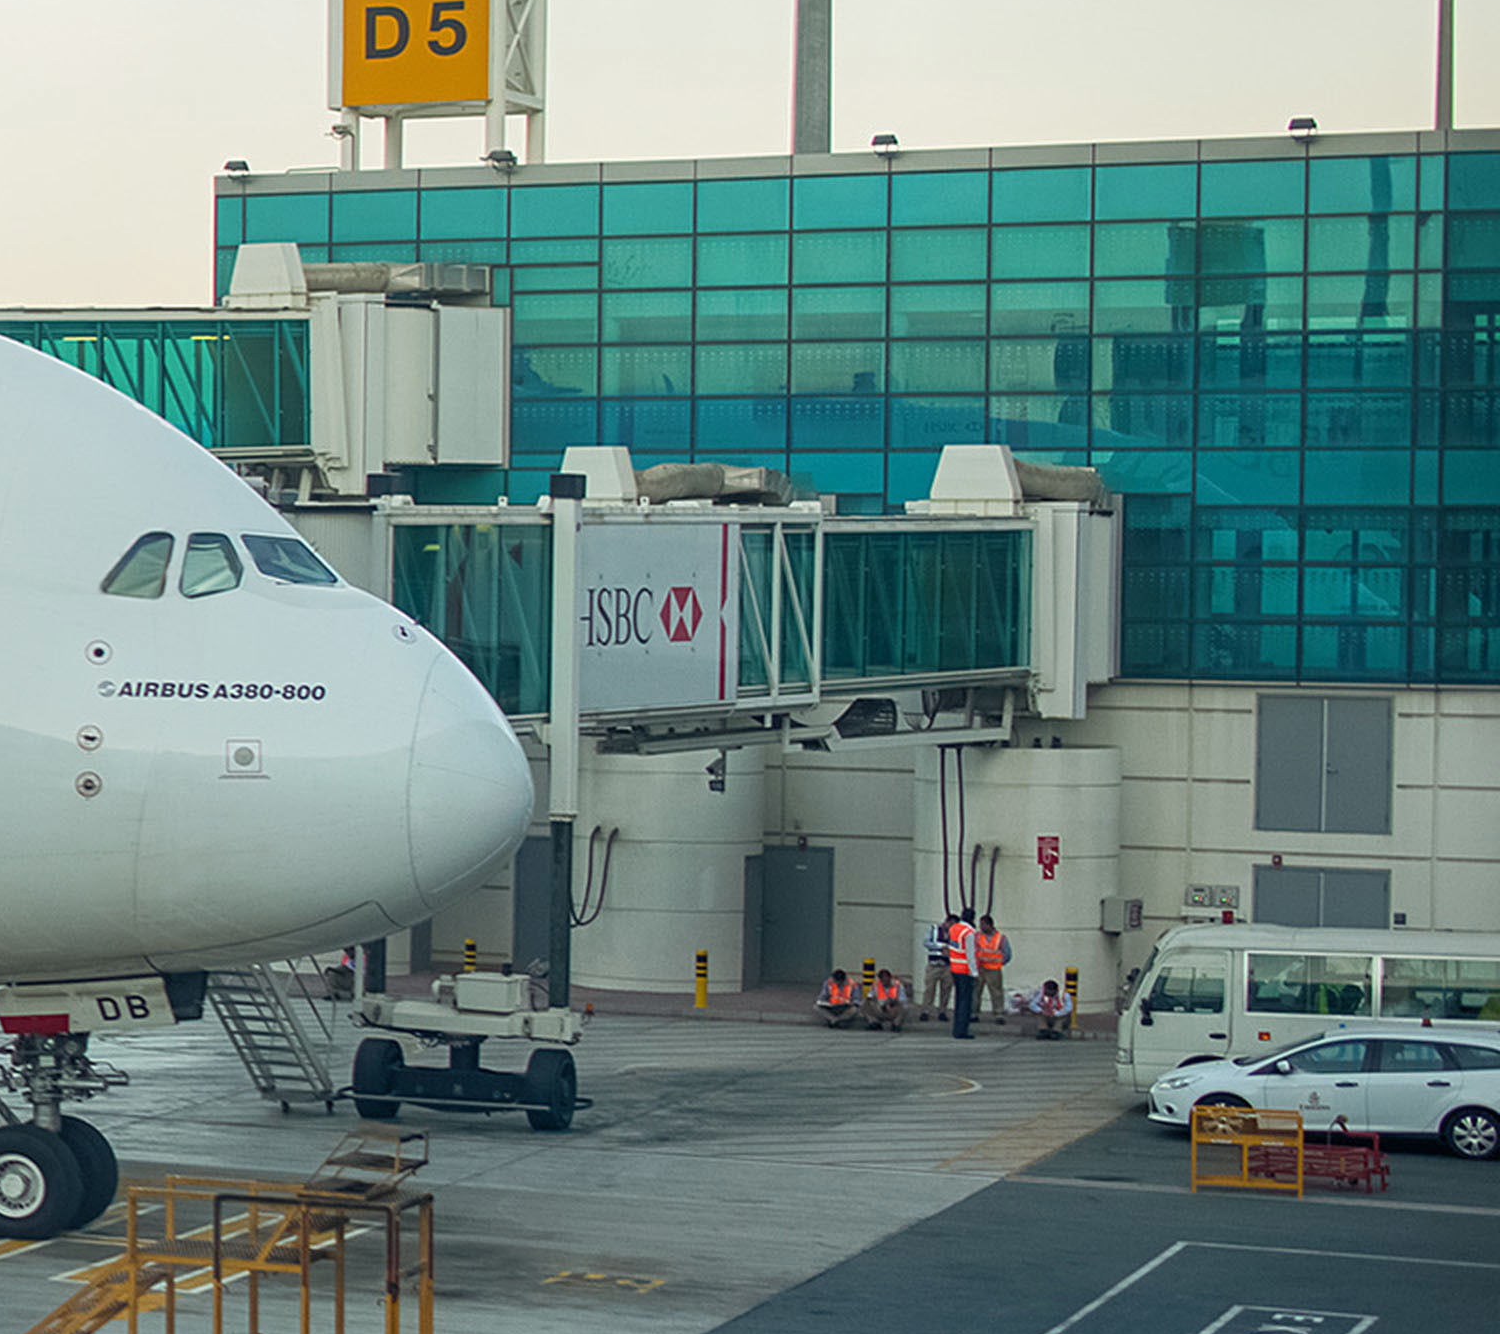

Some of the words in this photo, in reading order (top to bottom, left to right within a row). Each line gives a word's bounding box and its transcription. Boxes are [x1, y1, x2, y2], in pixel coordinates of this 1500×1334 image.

[363, 5, 410, 61] D
[427, 0, 468, 57] 5
[579, 587, 653, 647] HSBC
[117, 681, 211, 699] AIRBUS
[212, 683, 327, 701] A380-800
[95, 994, 150, 1022] DB
